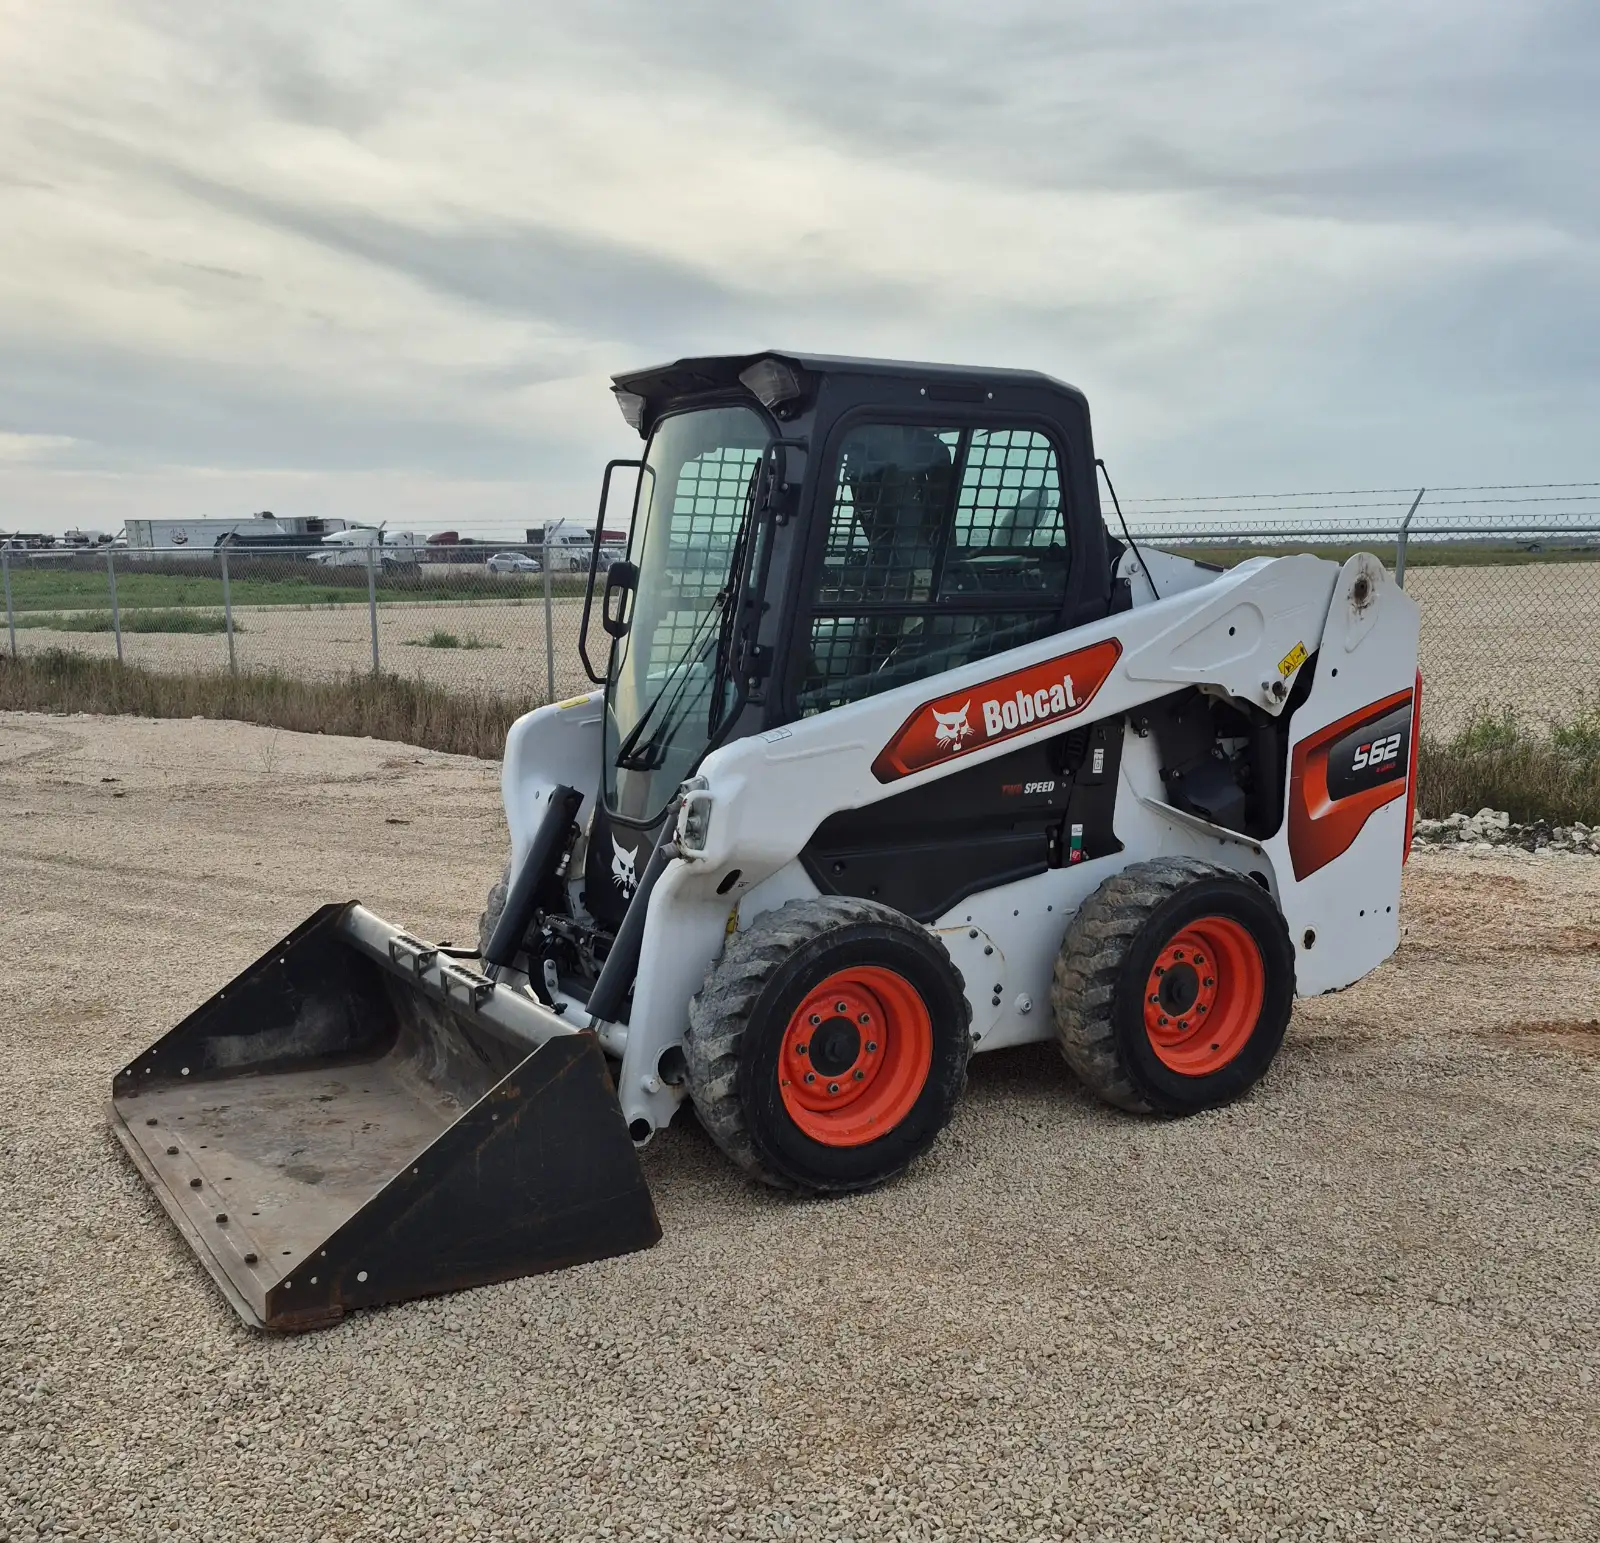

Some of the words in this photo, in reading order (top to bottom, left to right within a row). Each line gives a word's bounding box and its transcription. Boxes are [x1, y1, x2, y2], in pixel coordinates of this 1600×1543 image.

[982, 674, 1077, 737] Bobcat
[1351, 733, 1402, 771] S62
[1024, 781, 1055, 794] SPEED
